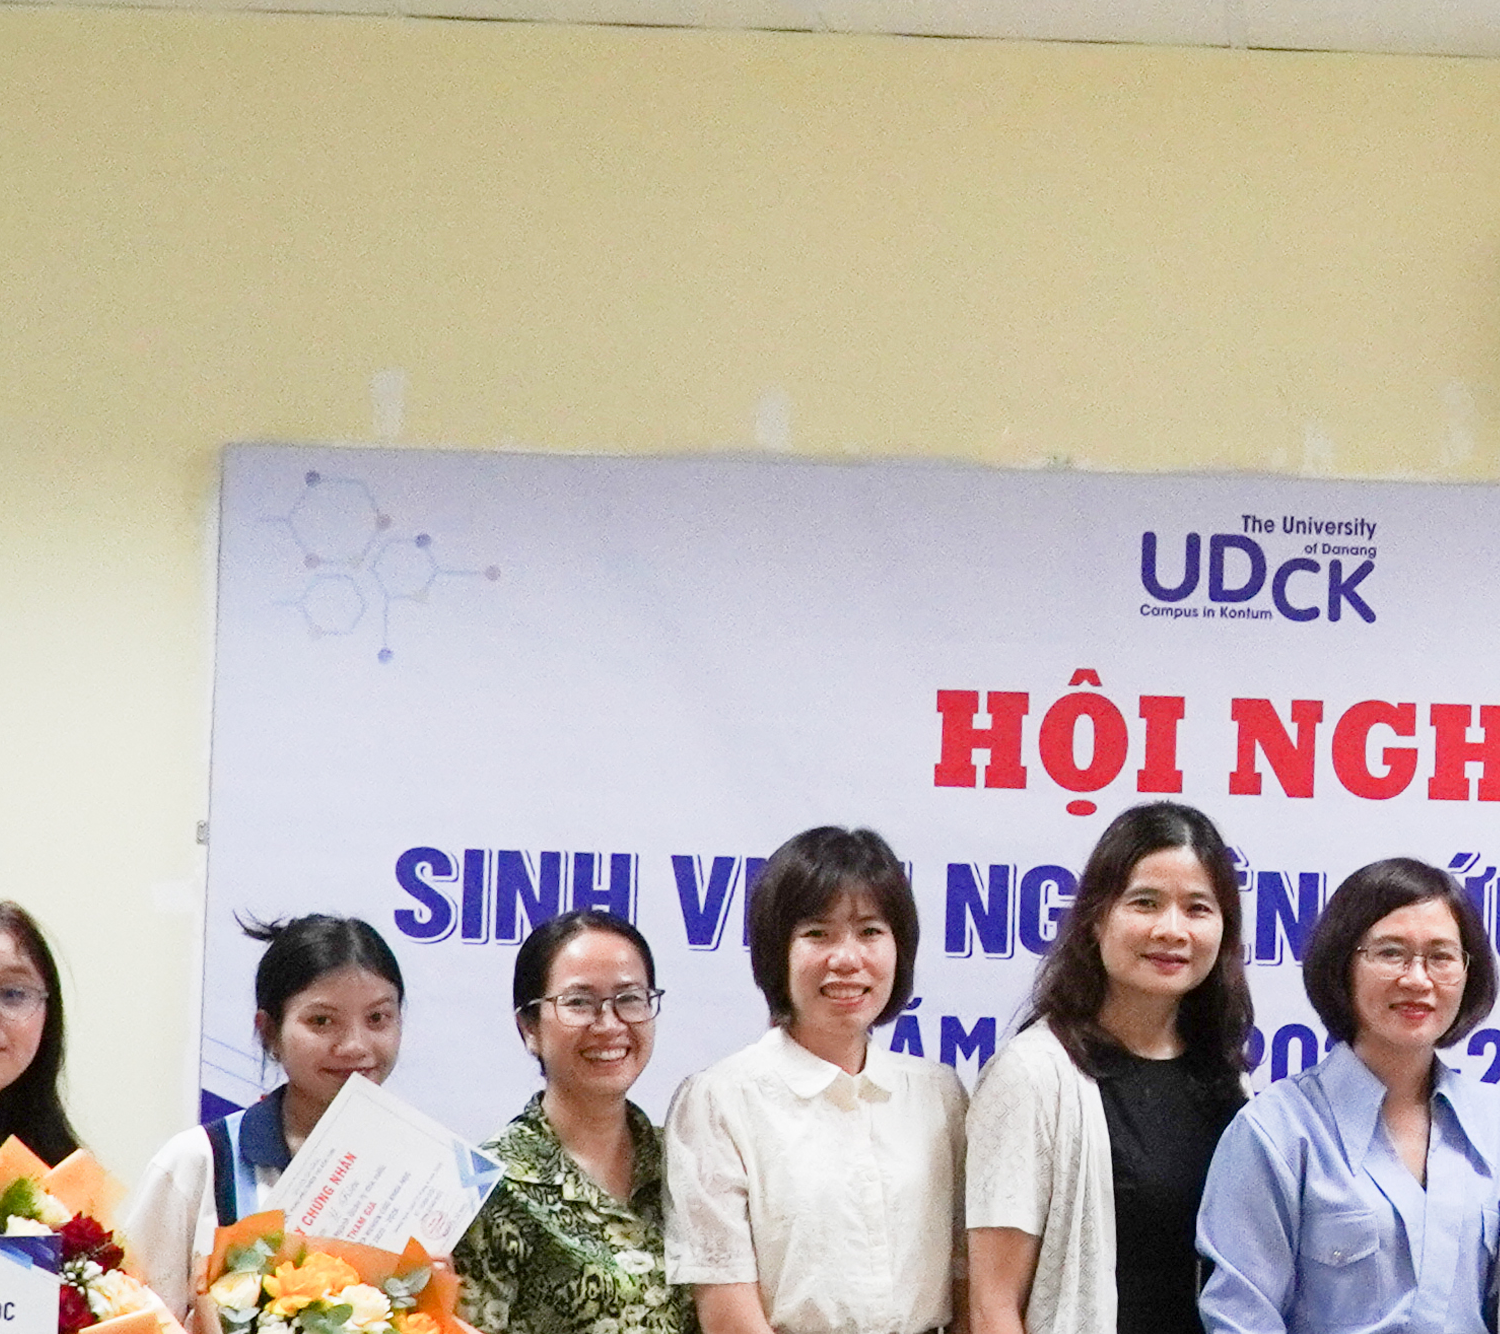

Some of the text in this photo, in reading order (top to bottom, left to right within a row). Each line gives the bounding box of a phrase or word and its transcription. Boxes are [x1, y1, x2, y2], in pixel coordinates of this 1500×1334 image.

[1242, 515, 1376, 540] The University
[1304, 544, 1377, 558] of Danang
[1141, 531, 1376, 623] UDCK
[1140, 604, 1273, 620] Campus in Kontum
[934, 668, 1185, 817] HỘI
[393, 846, 638, 945] SINH
